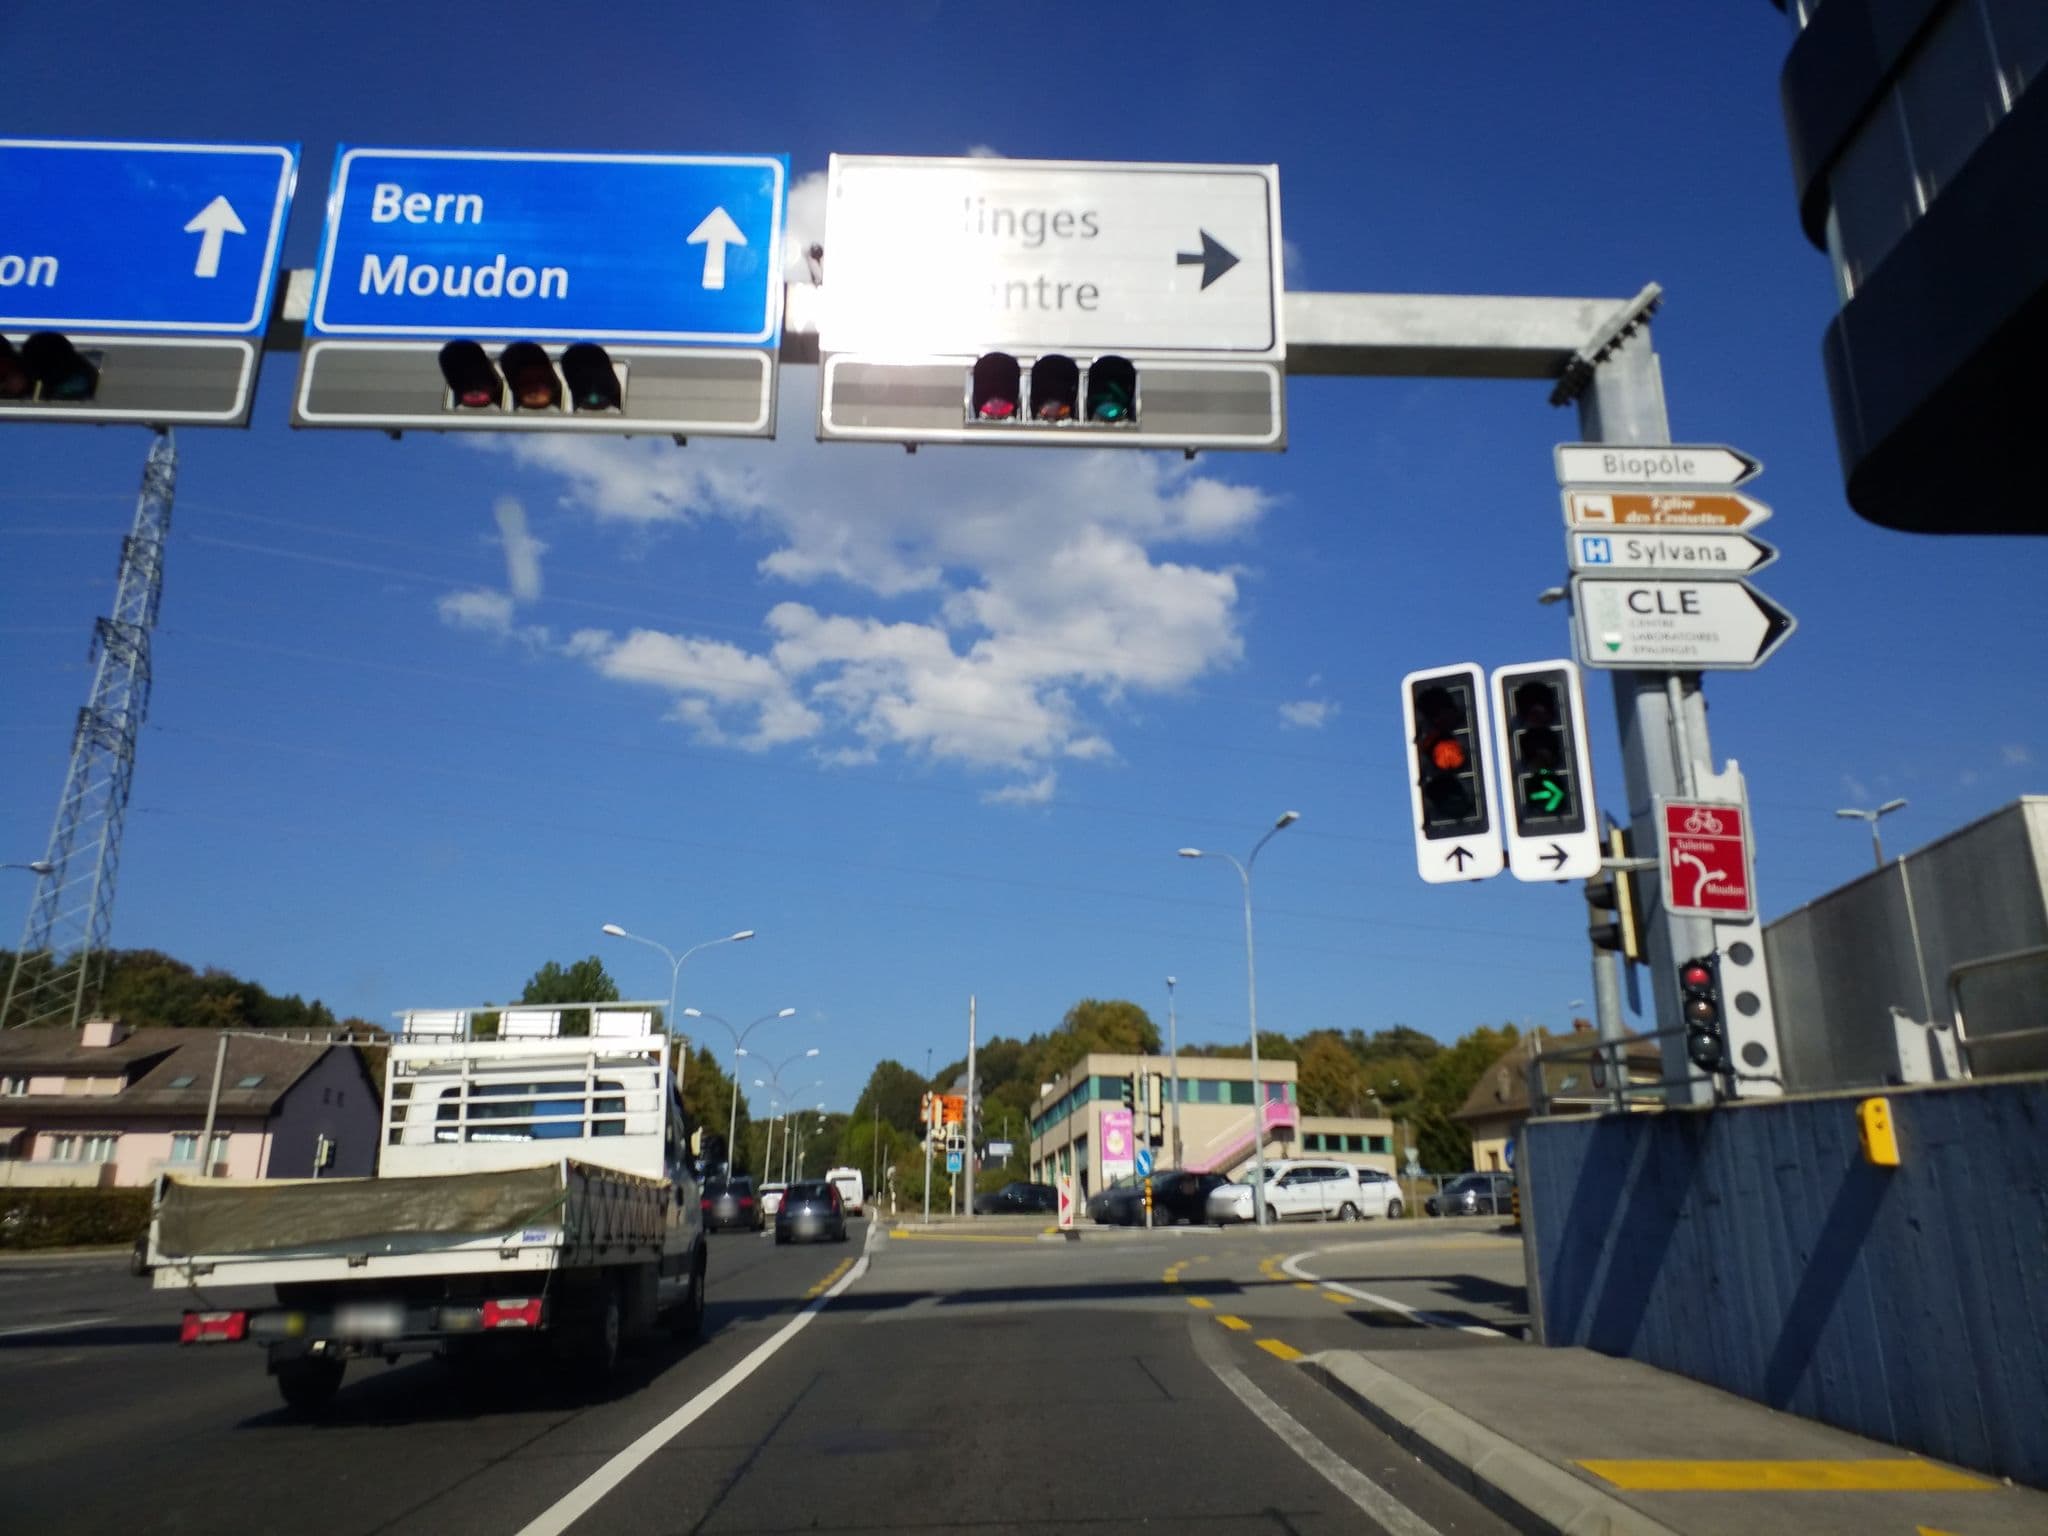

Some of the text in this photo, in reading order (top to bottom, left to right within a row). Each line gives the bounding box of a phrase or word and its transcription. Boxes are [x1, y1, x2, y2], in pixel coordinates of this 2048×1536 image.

[371, 183, 484, 225] Bern
[359, 253, 569, 299] Moudon
[1602, 453, 1696, 478] Biopôle
[1627, 540, 1728, 565] Sylvana
[1627, 589, 1702, 615] CLE
